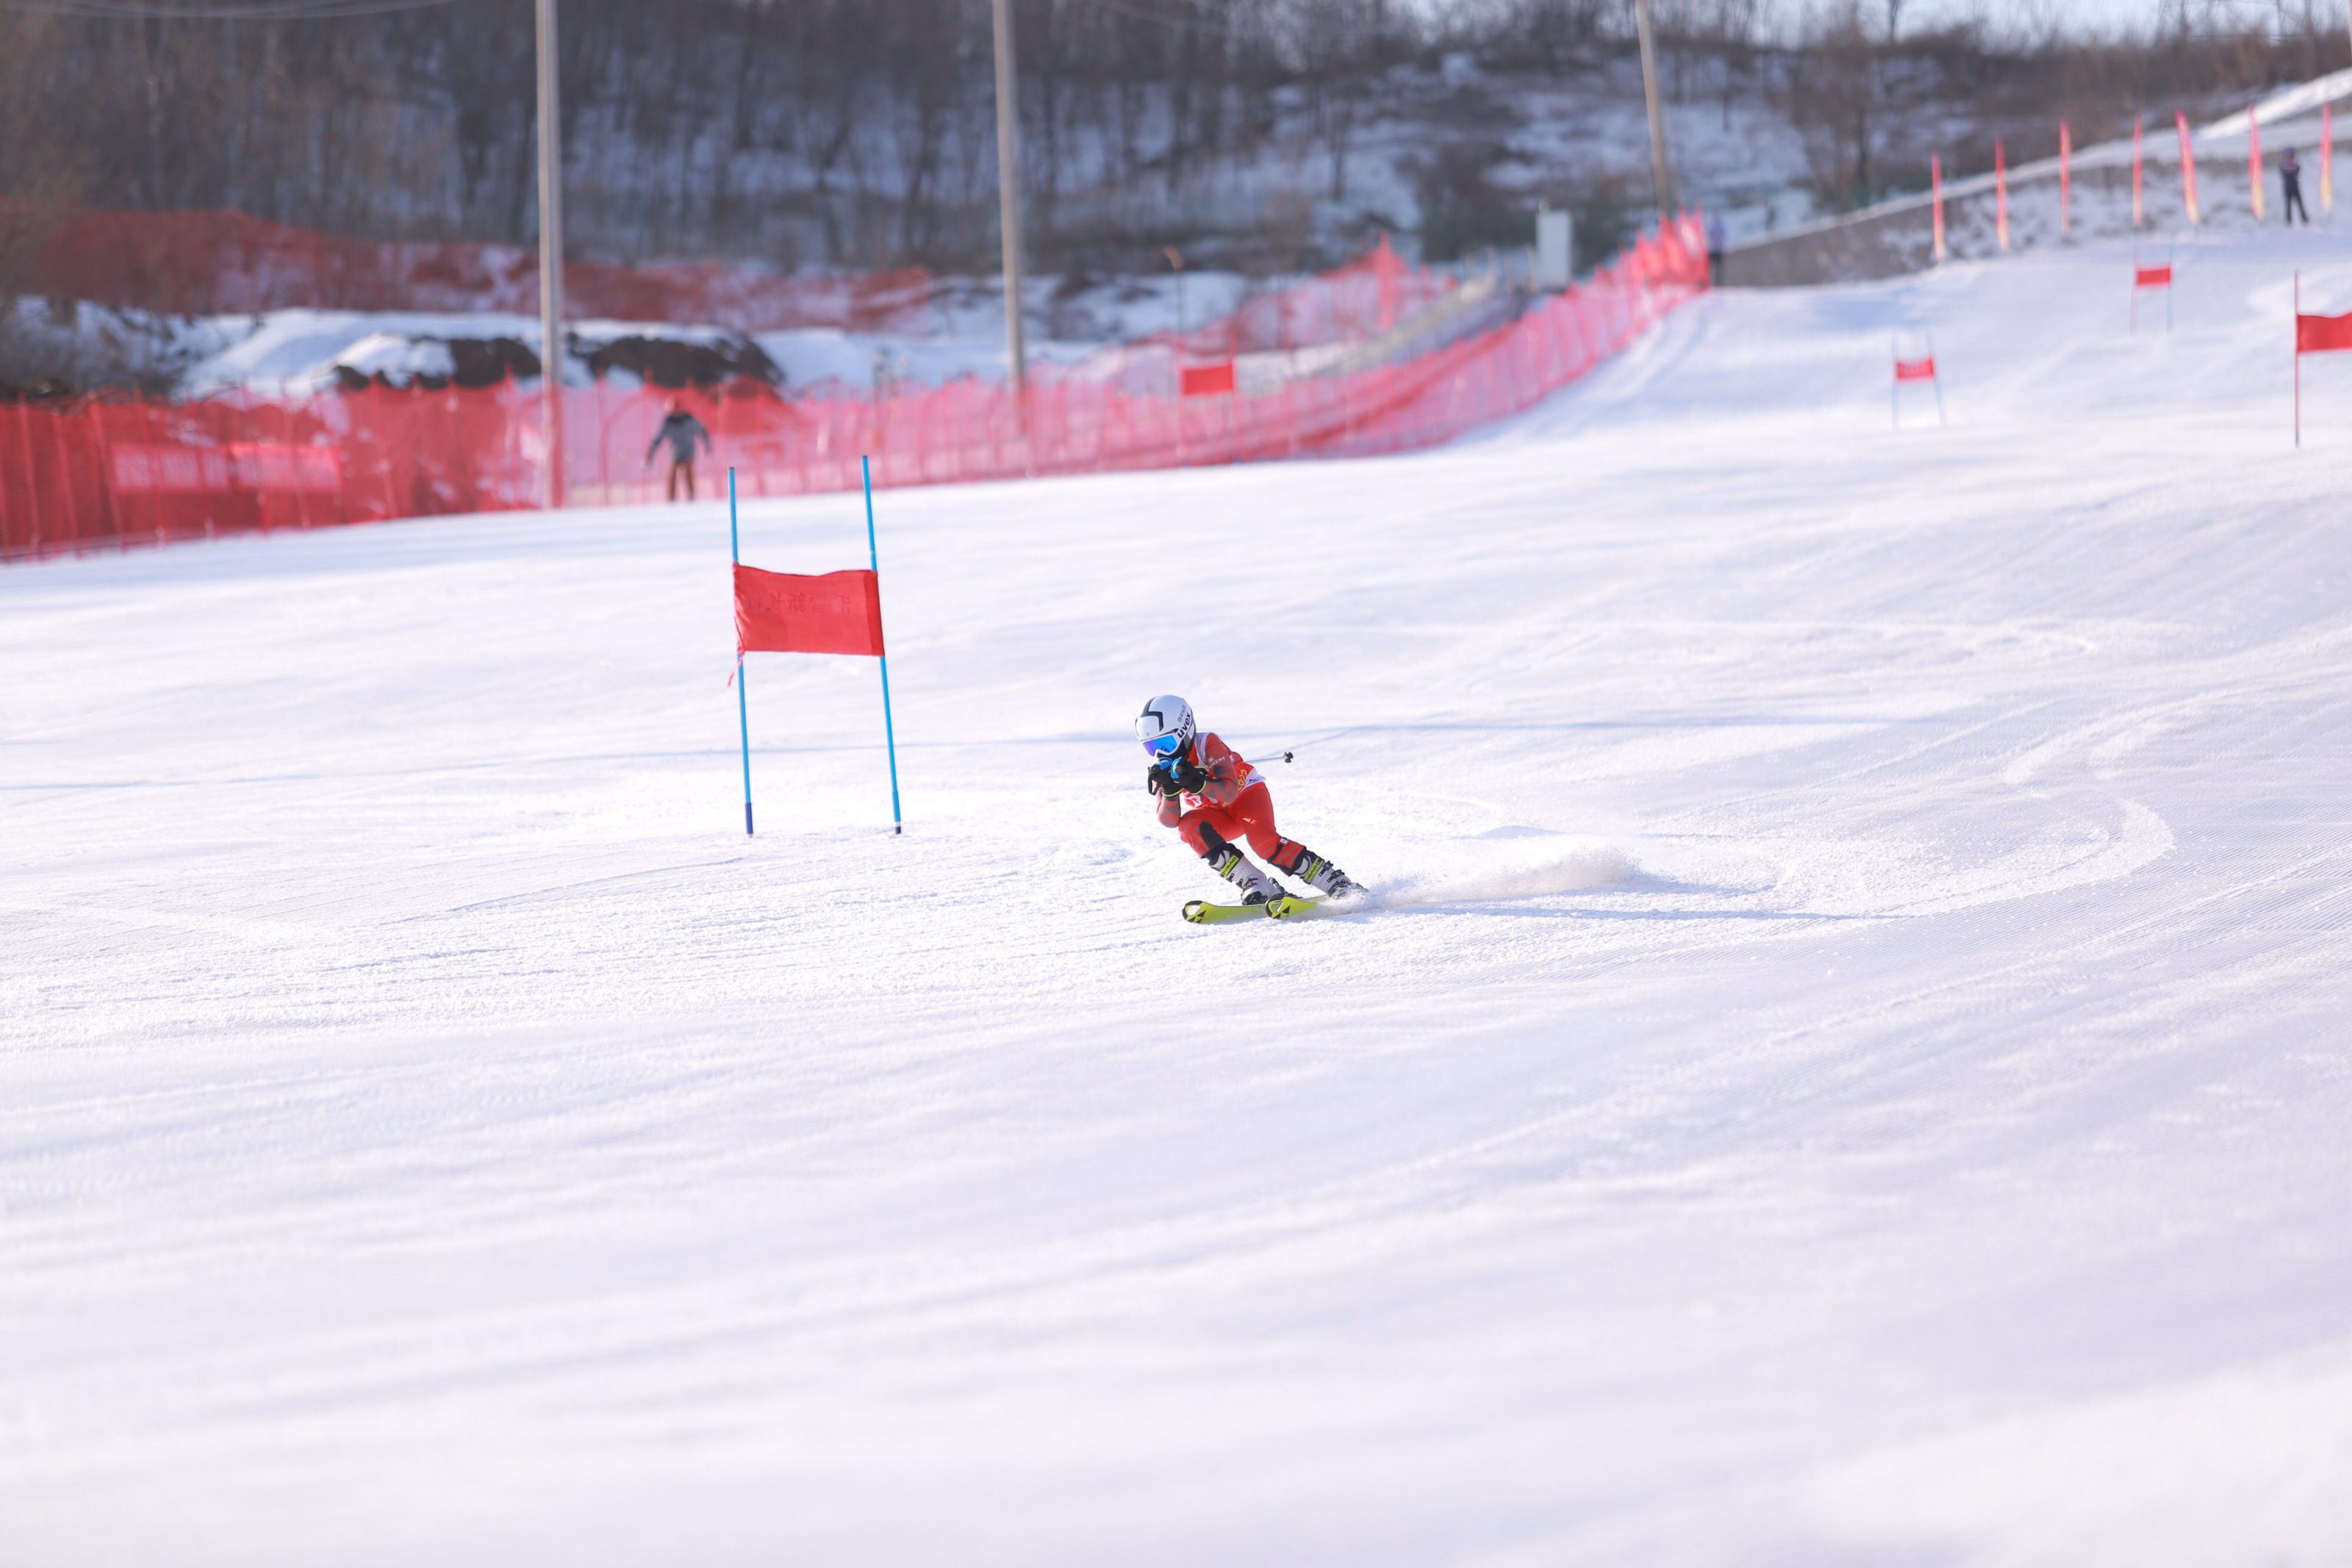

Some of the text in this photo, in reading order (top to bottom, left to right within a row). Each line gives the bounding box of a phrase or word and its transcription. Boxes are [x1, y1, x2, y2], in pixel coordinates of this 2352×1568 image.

[1177, 712, 1191, 738] uvex
[1223, 857, 1237, 874] HEAD
[1305, 865, 1317, 880] HEAD
